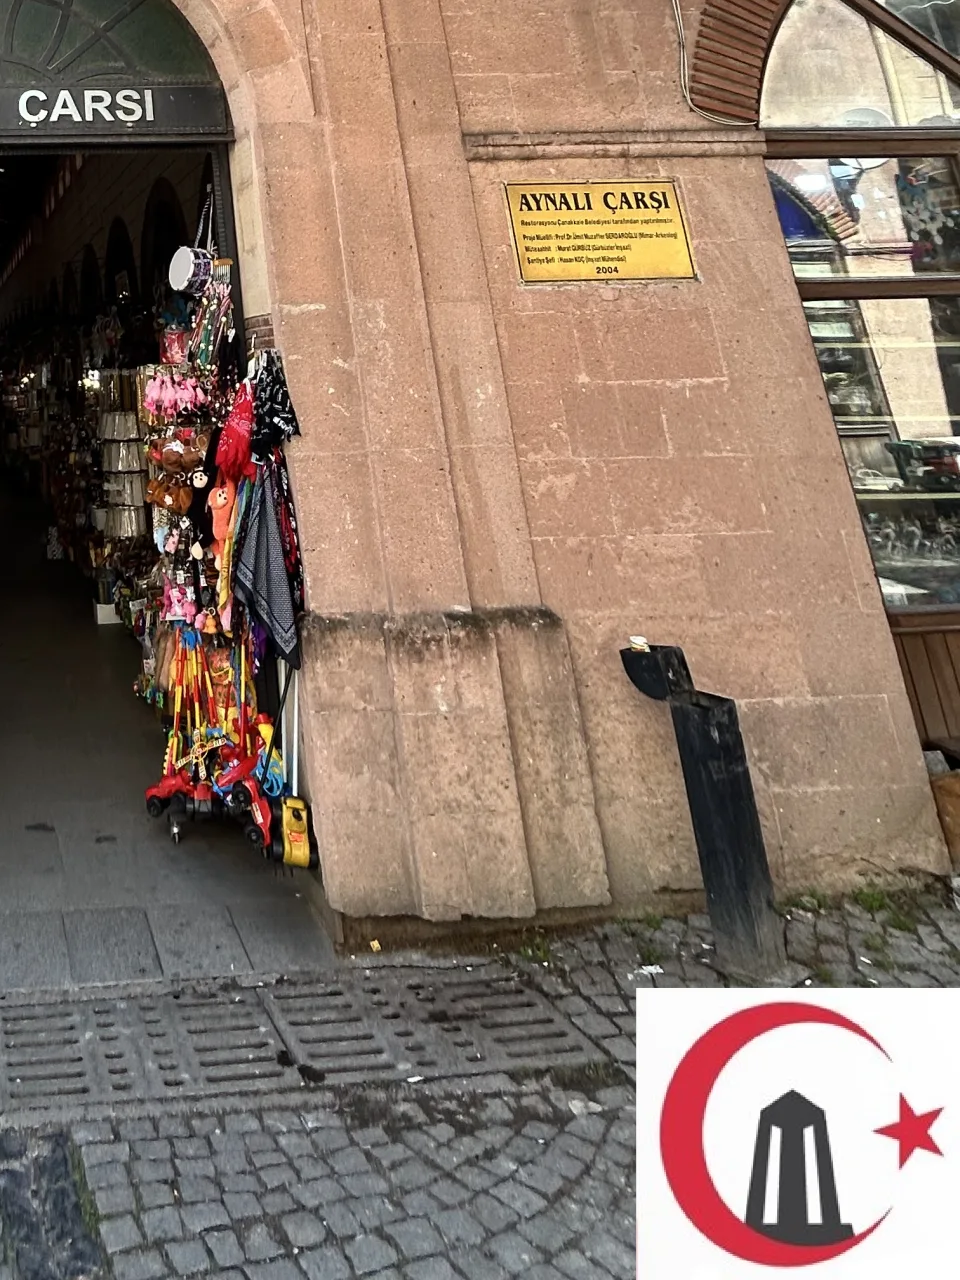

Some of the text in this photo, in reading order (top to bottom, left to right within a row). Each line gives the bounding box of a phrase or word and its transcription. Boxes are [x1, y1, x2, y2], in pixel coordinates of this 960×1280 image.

[18, 89, 155, 127] ÇARŞI
[519, 191, 670, 214] AYNALI ÇARŞI
[596, 266, 619, 274] 2004
